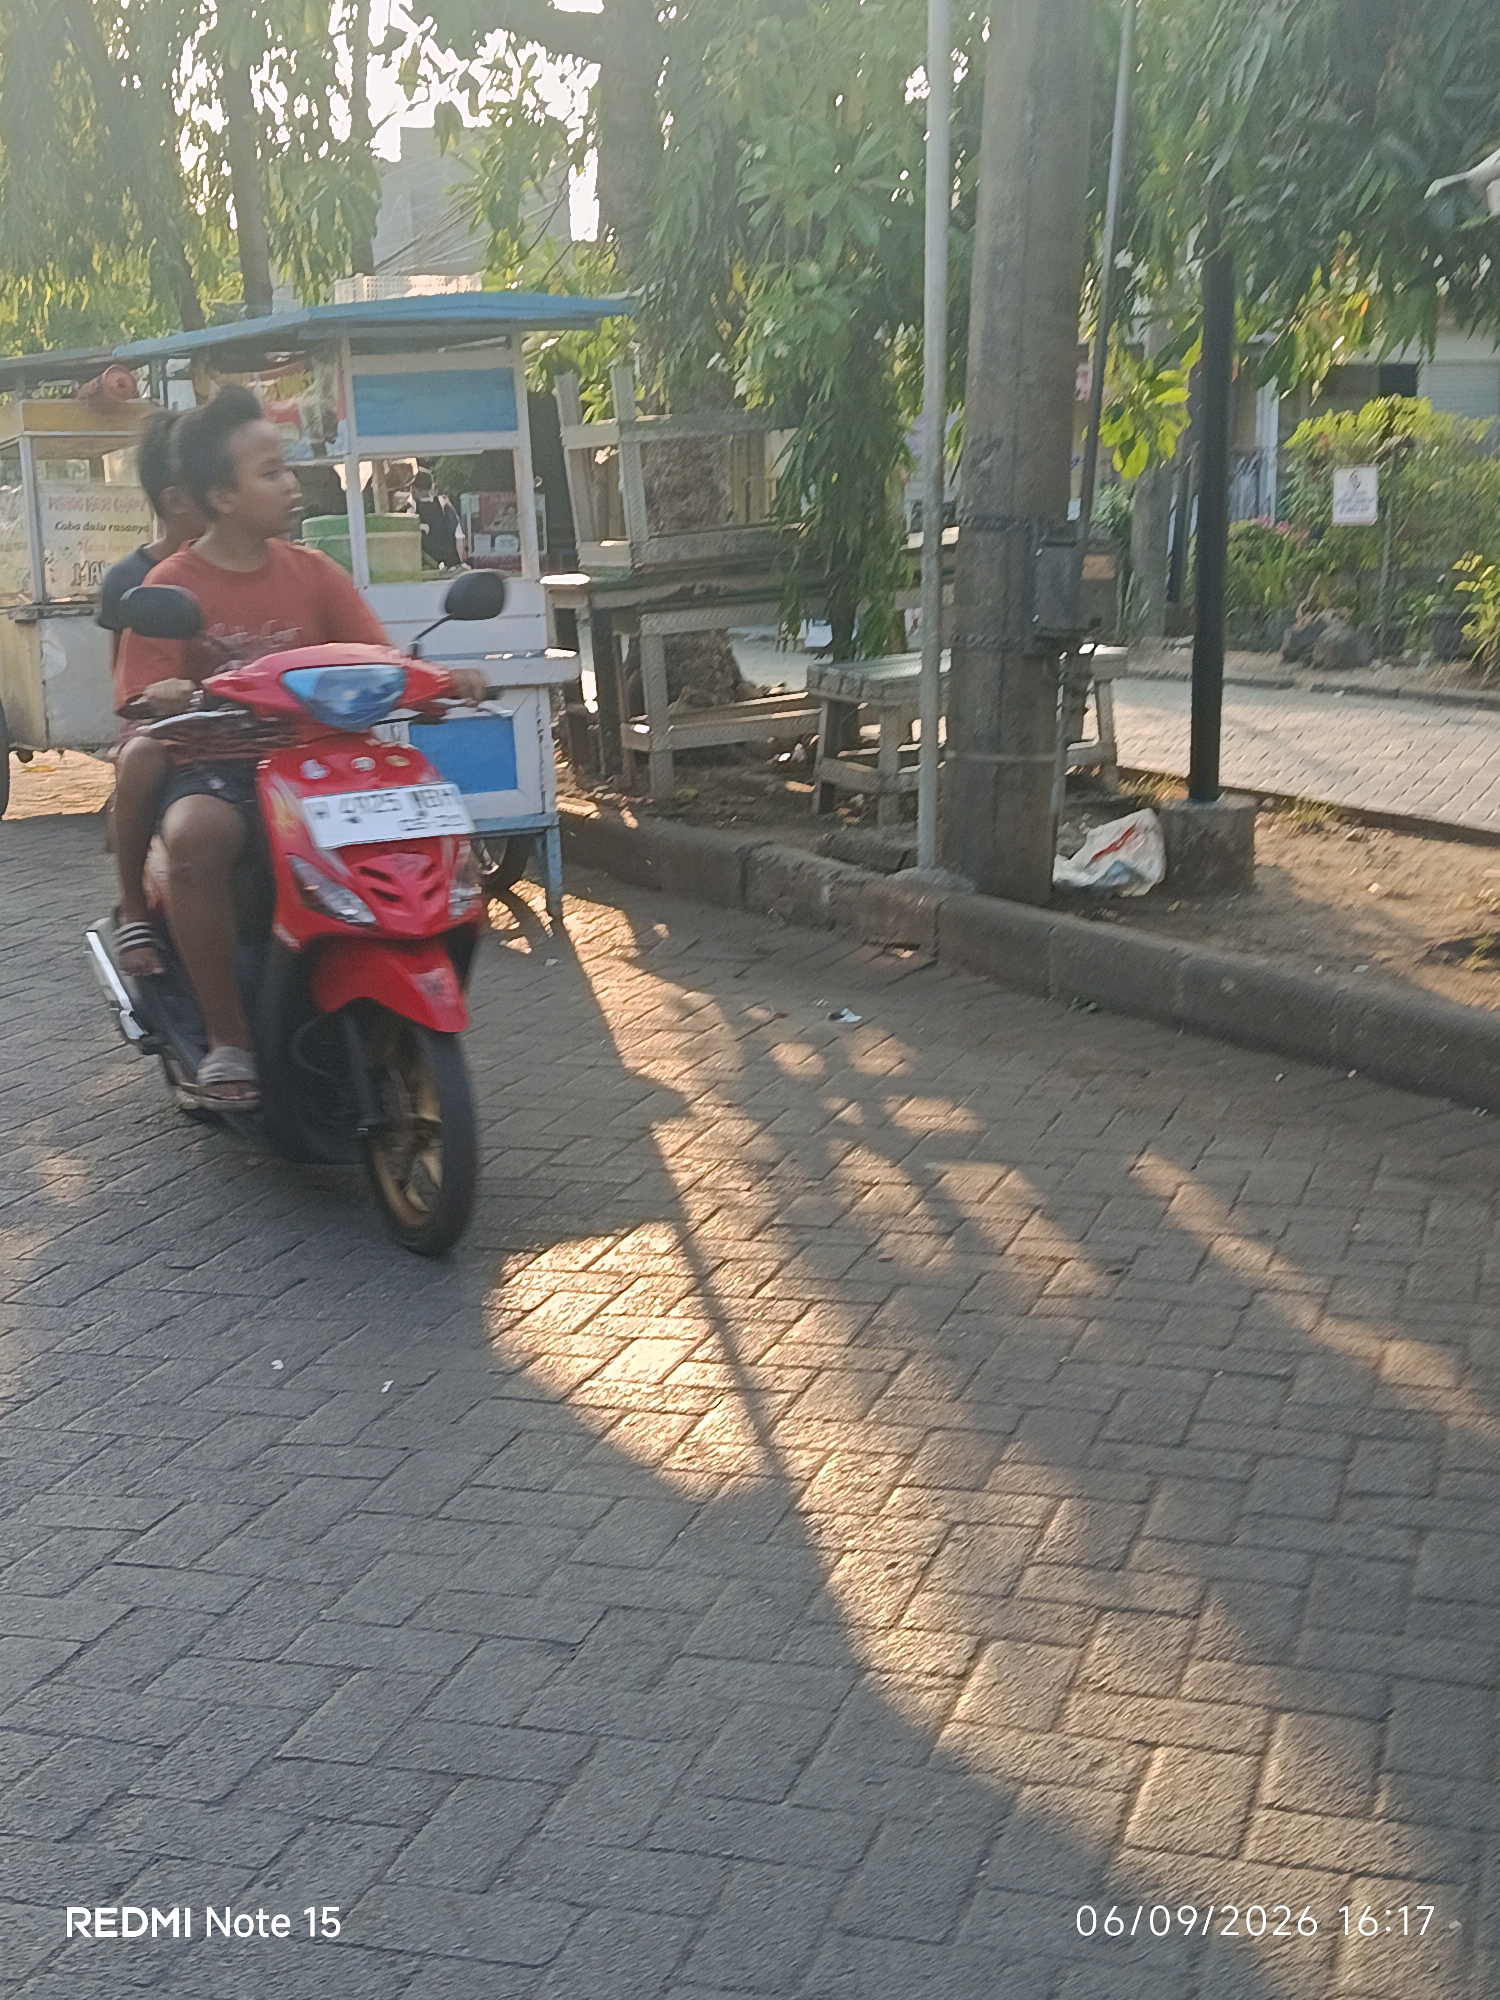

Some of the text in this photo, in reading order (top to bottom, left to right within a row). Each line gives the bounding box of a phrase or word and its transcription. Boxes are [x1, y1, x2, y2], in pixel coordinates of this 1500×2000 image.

[54, 520, 150, 535] Coba dulu rasanya
